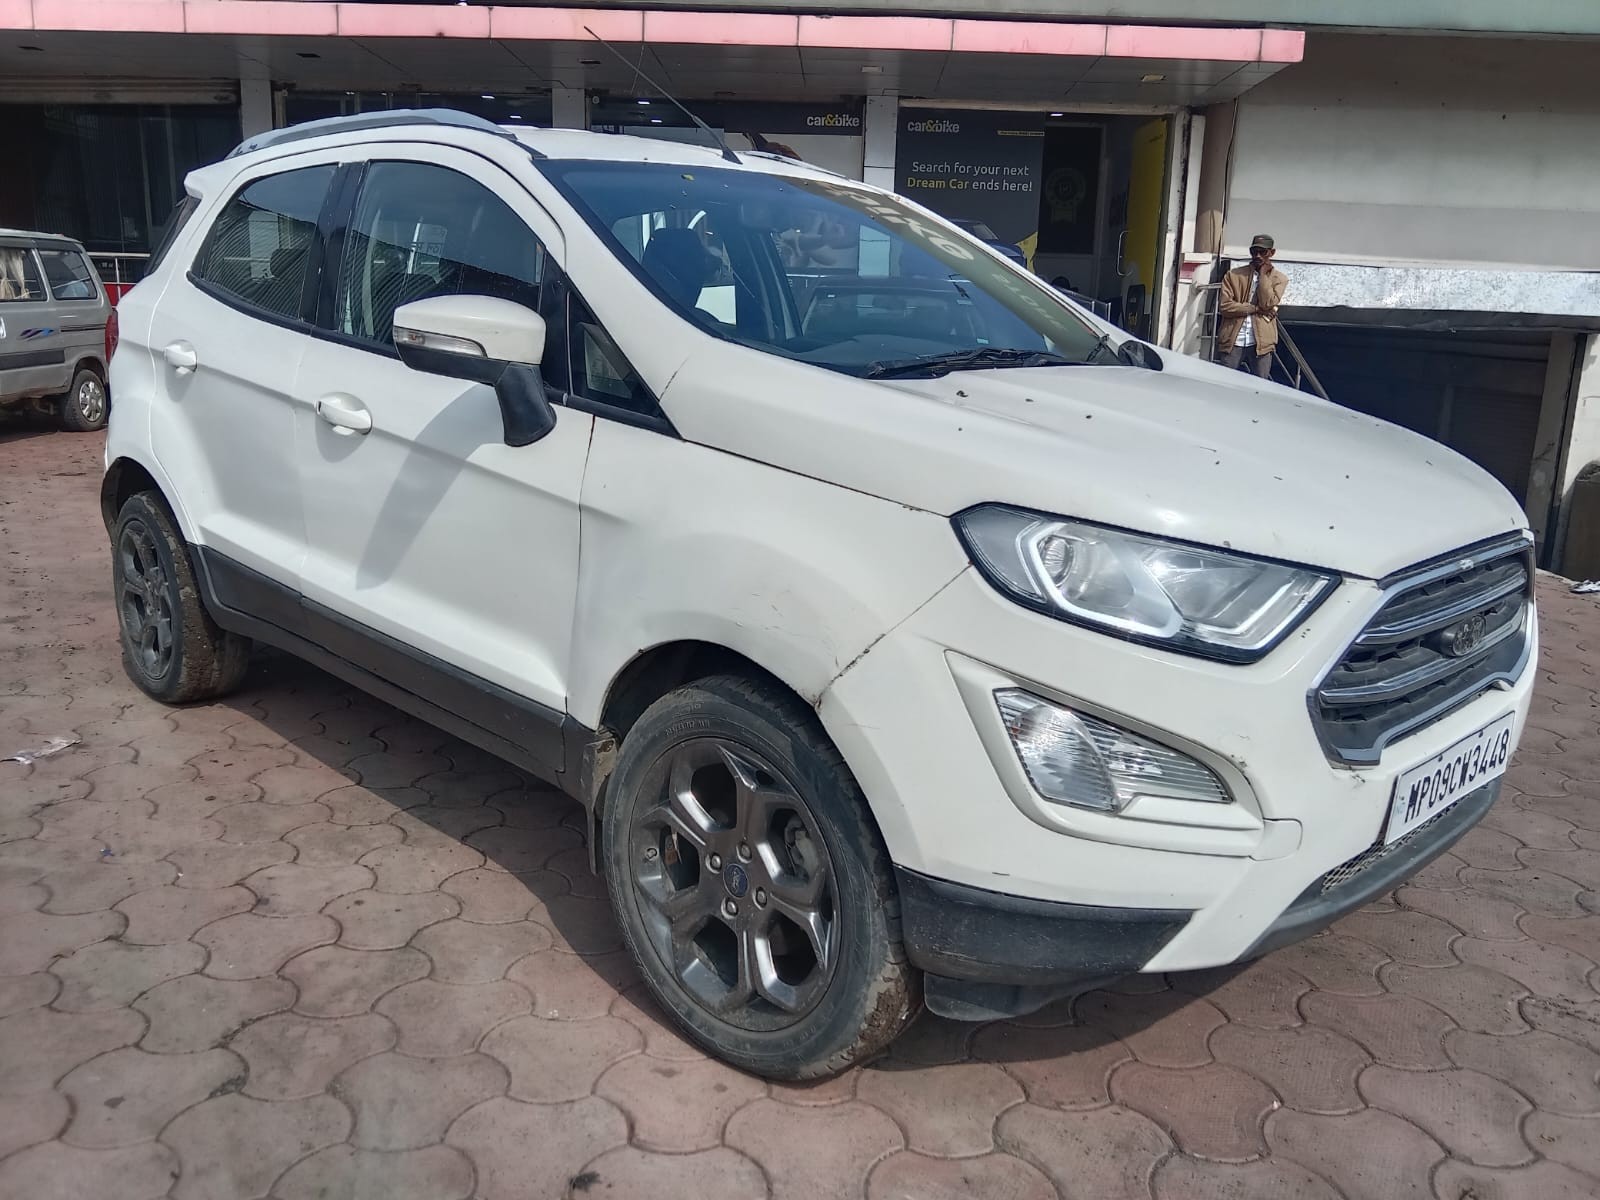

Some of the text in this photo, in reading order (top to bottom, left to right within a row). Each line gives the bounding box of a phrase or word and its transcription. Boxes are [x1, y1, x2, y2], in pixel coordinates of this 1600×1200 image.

[807, 114, 860, 127] car&bike
[907, 120, 960, 133] car&bike
[912, 161, 1029, 176] Search for your next
[907, 177, 1033, 192] Dream Car ends here!
[1404, 728, 1510, 823] MP09CW3448
